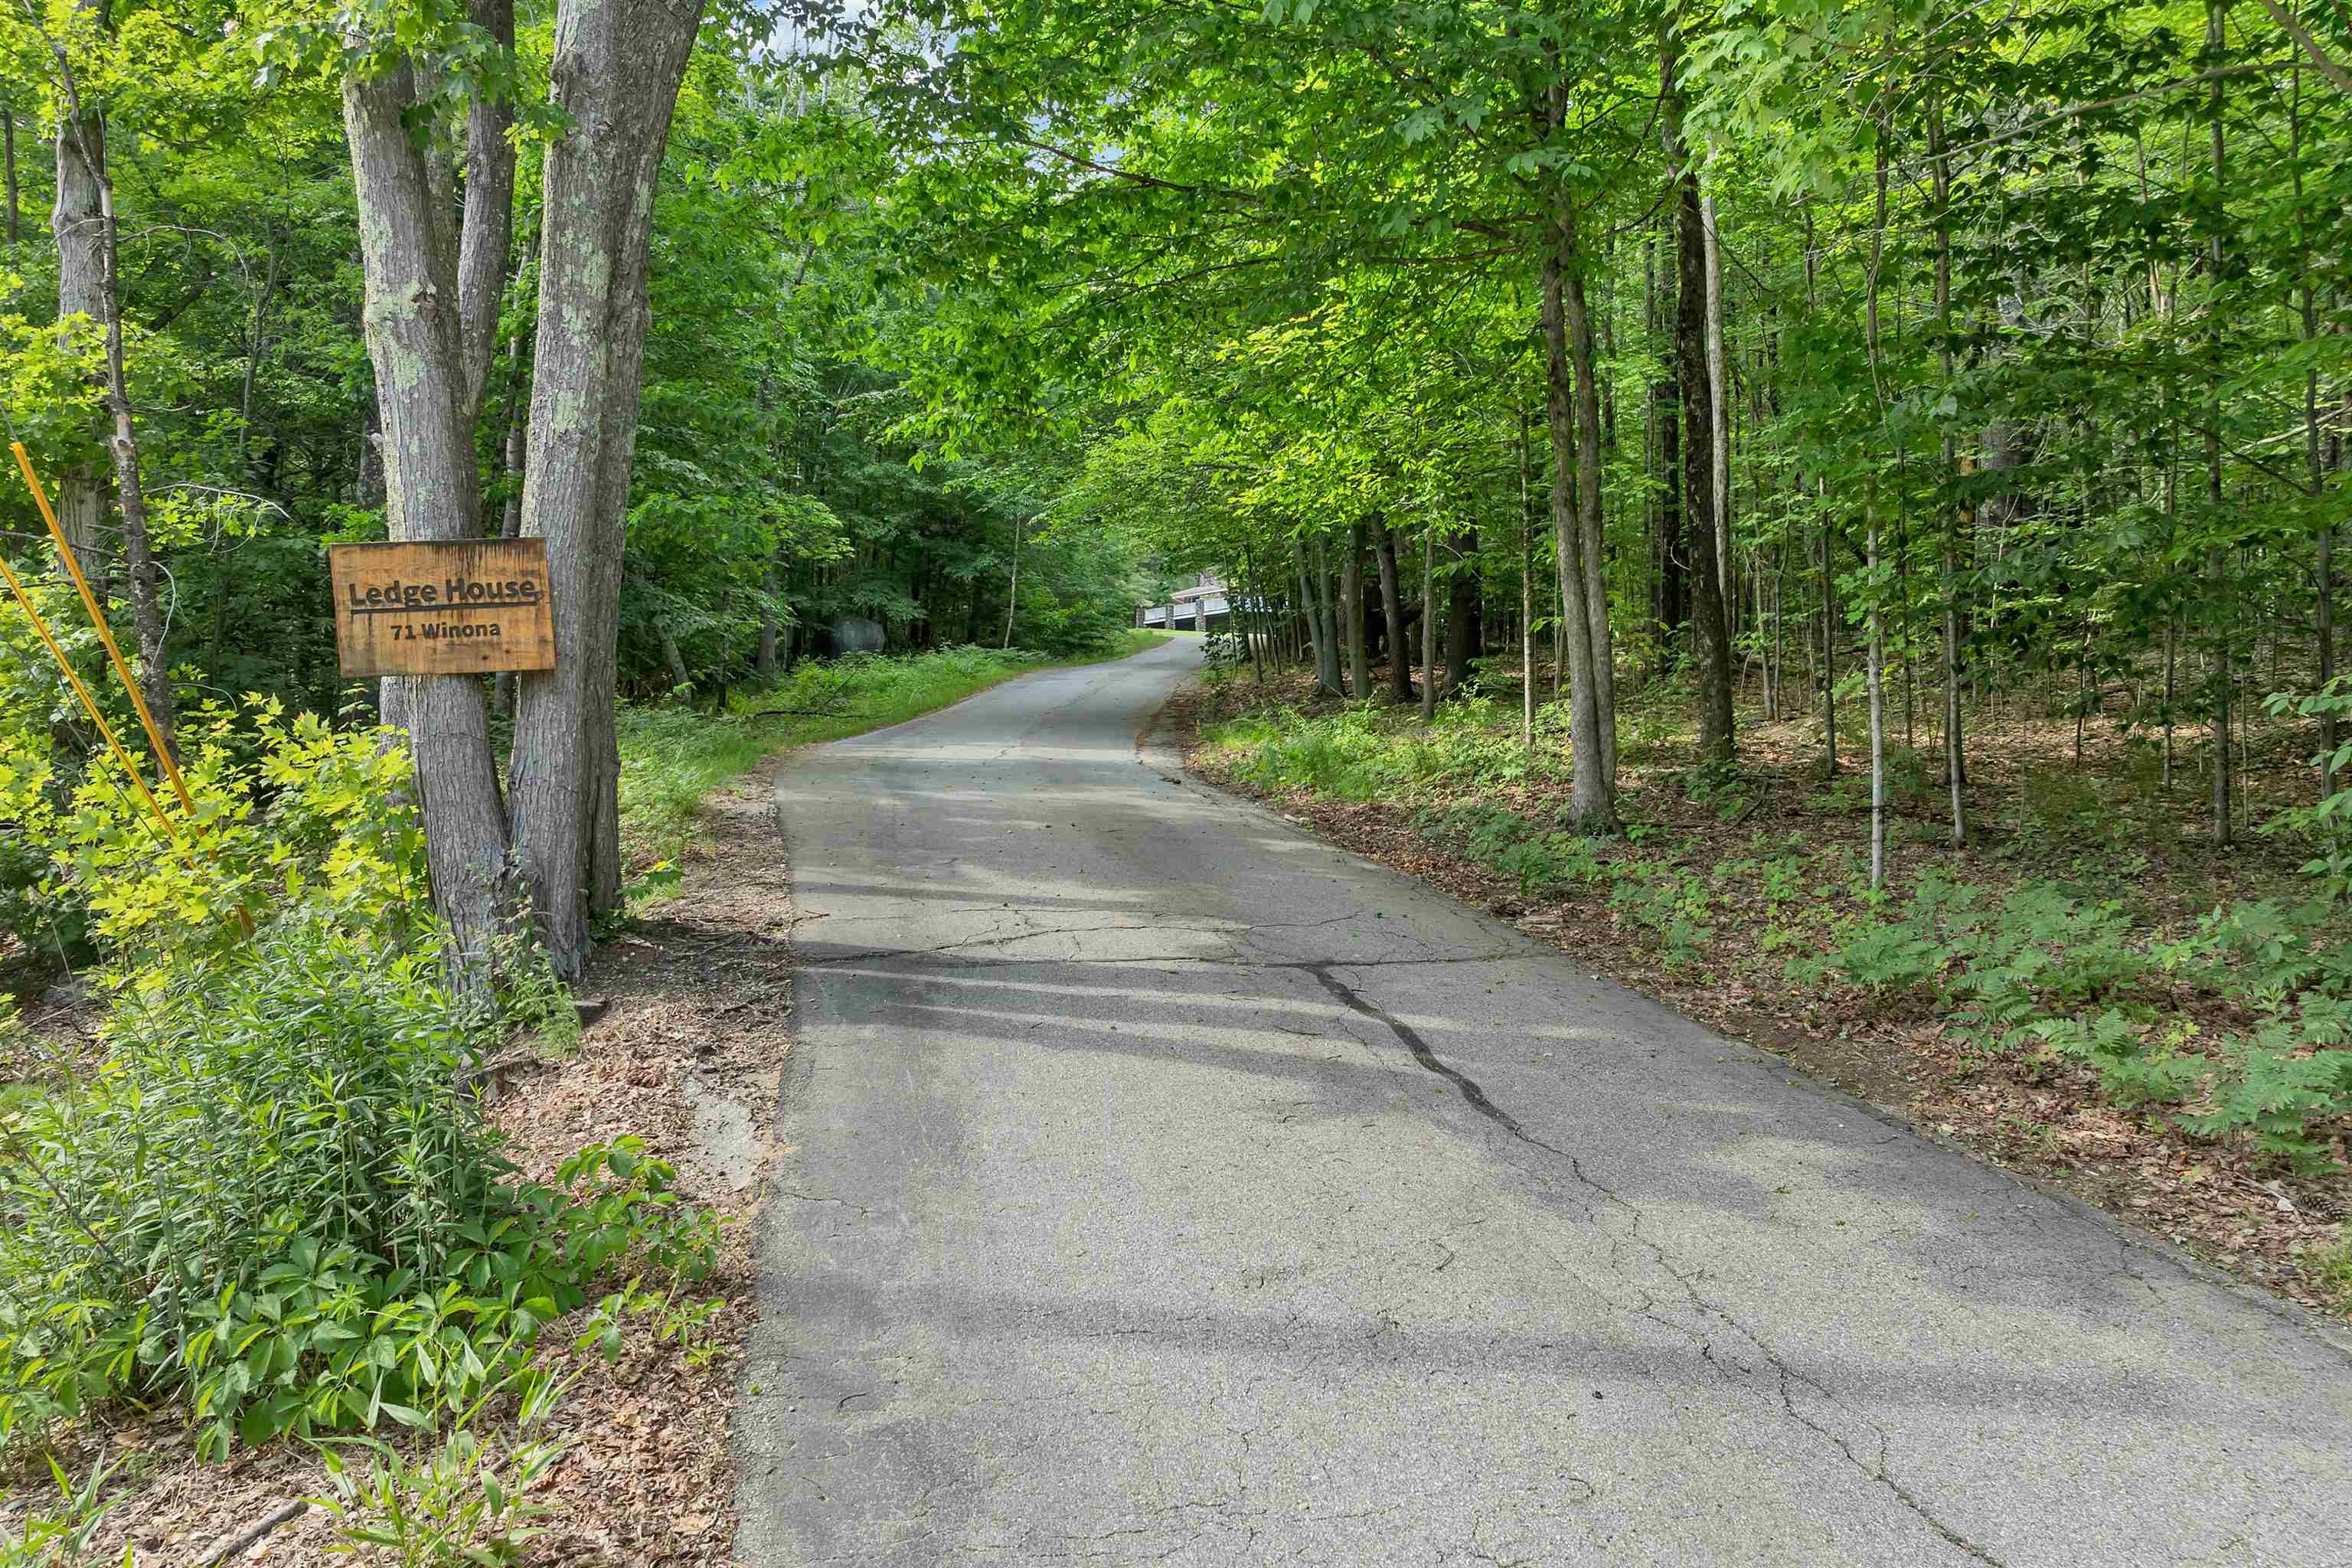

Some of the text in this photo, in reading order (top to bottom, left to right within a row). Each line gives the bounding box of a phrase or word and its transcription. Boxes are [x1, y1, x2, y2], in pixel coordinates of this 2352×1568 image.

[349, 577, 536, 607] Ledge House
[390, 621, 501, 640] 71 Winona
